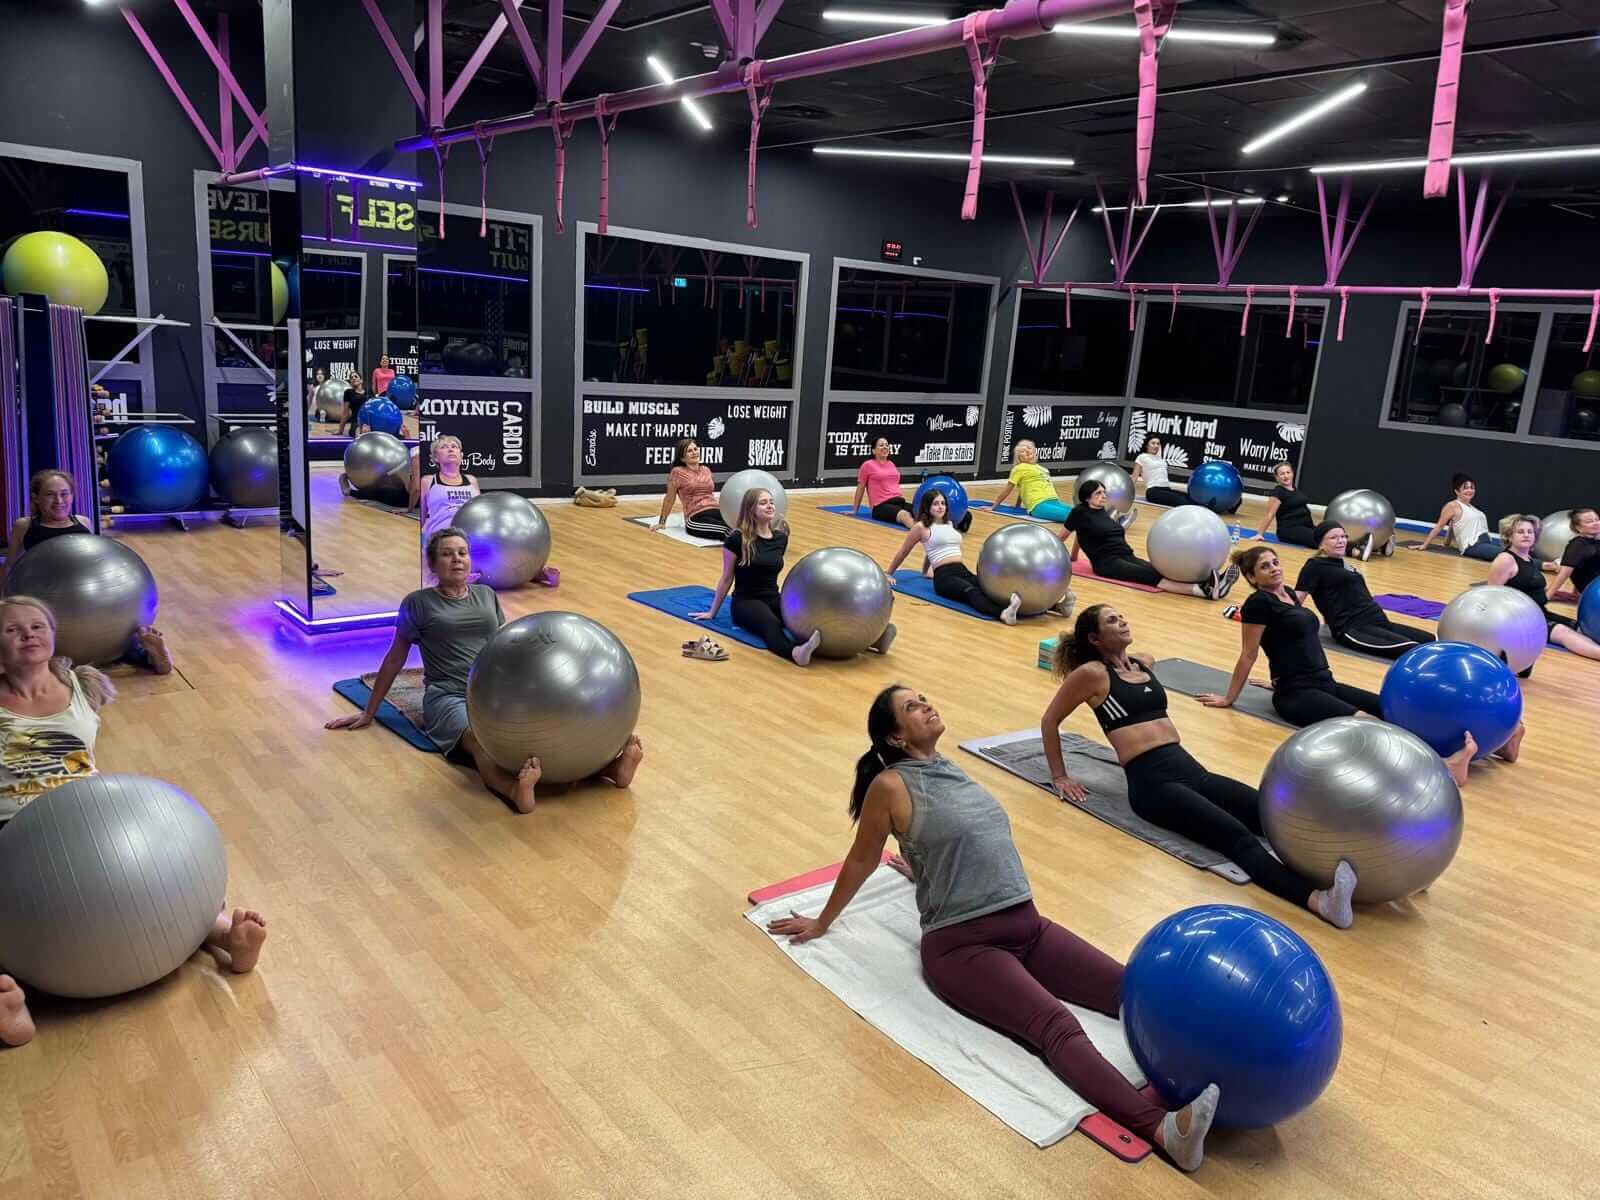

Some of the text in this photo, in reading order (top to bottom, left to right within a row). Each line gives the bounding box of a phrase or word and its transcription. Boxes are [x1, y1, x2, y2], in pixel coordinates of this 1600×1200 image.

[314, 340, 357, 351] LOSE WEIGHT
[583, 400, 680, 416] BUILD MUSCLE
[727, 405, 787, 419] LOSE WEIGHT
[856, 413, 914, 426] AEROBICS
[1061, 415, 1083, 427] GET
[1147, 412, 1218, 440] Work hard
[502, 401, 523, 465] CARDIO
[606, 422, 698, 438] MAKE IT HAPPEN
[827, 432, 868, 444] TODAY
[1059, 427, 1100, 440] MOVING
[585, 428, 598, 467] Exercise
[696, 446, 724, 464] URN
[835, 444, 848, 456] IS
[888, 444, 901, 455] AY
[1204, 440, 1226, 458] Stay
[1240, 437, 1289, 462] Worry less
[468, 452, 496, 471] Body
[748, 450, 784, 466] SWEAT
